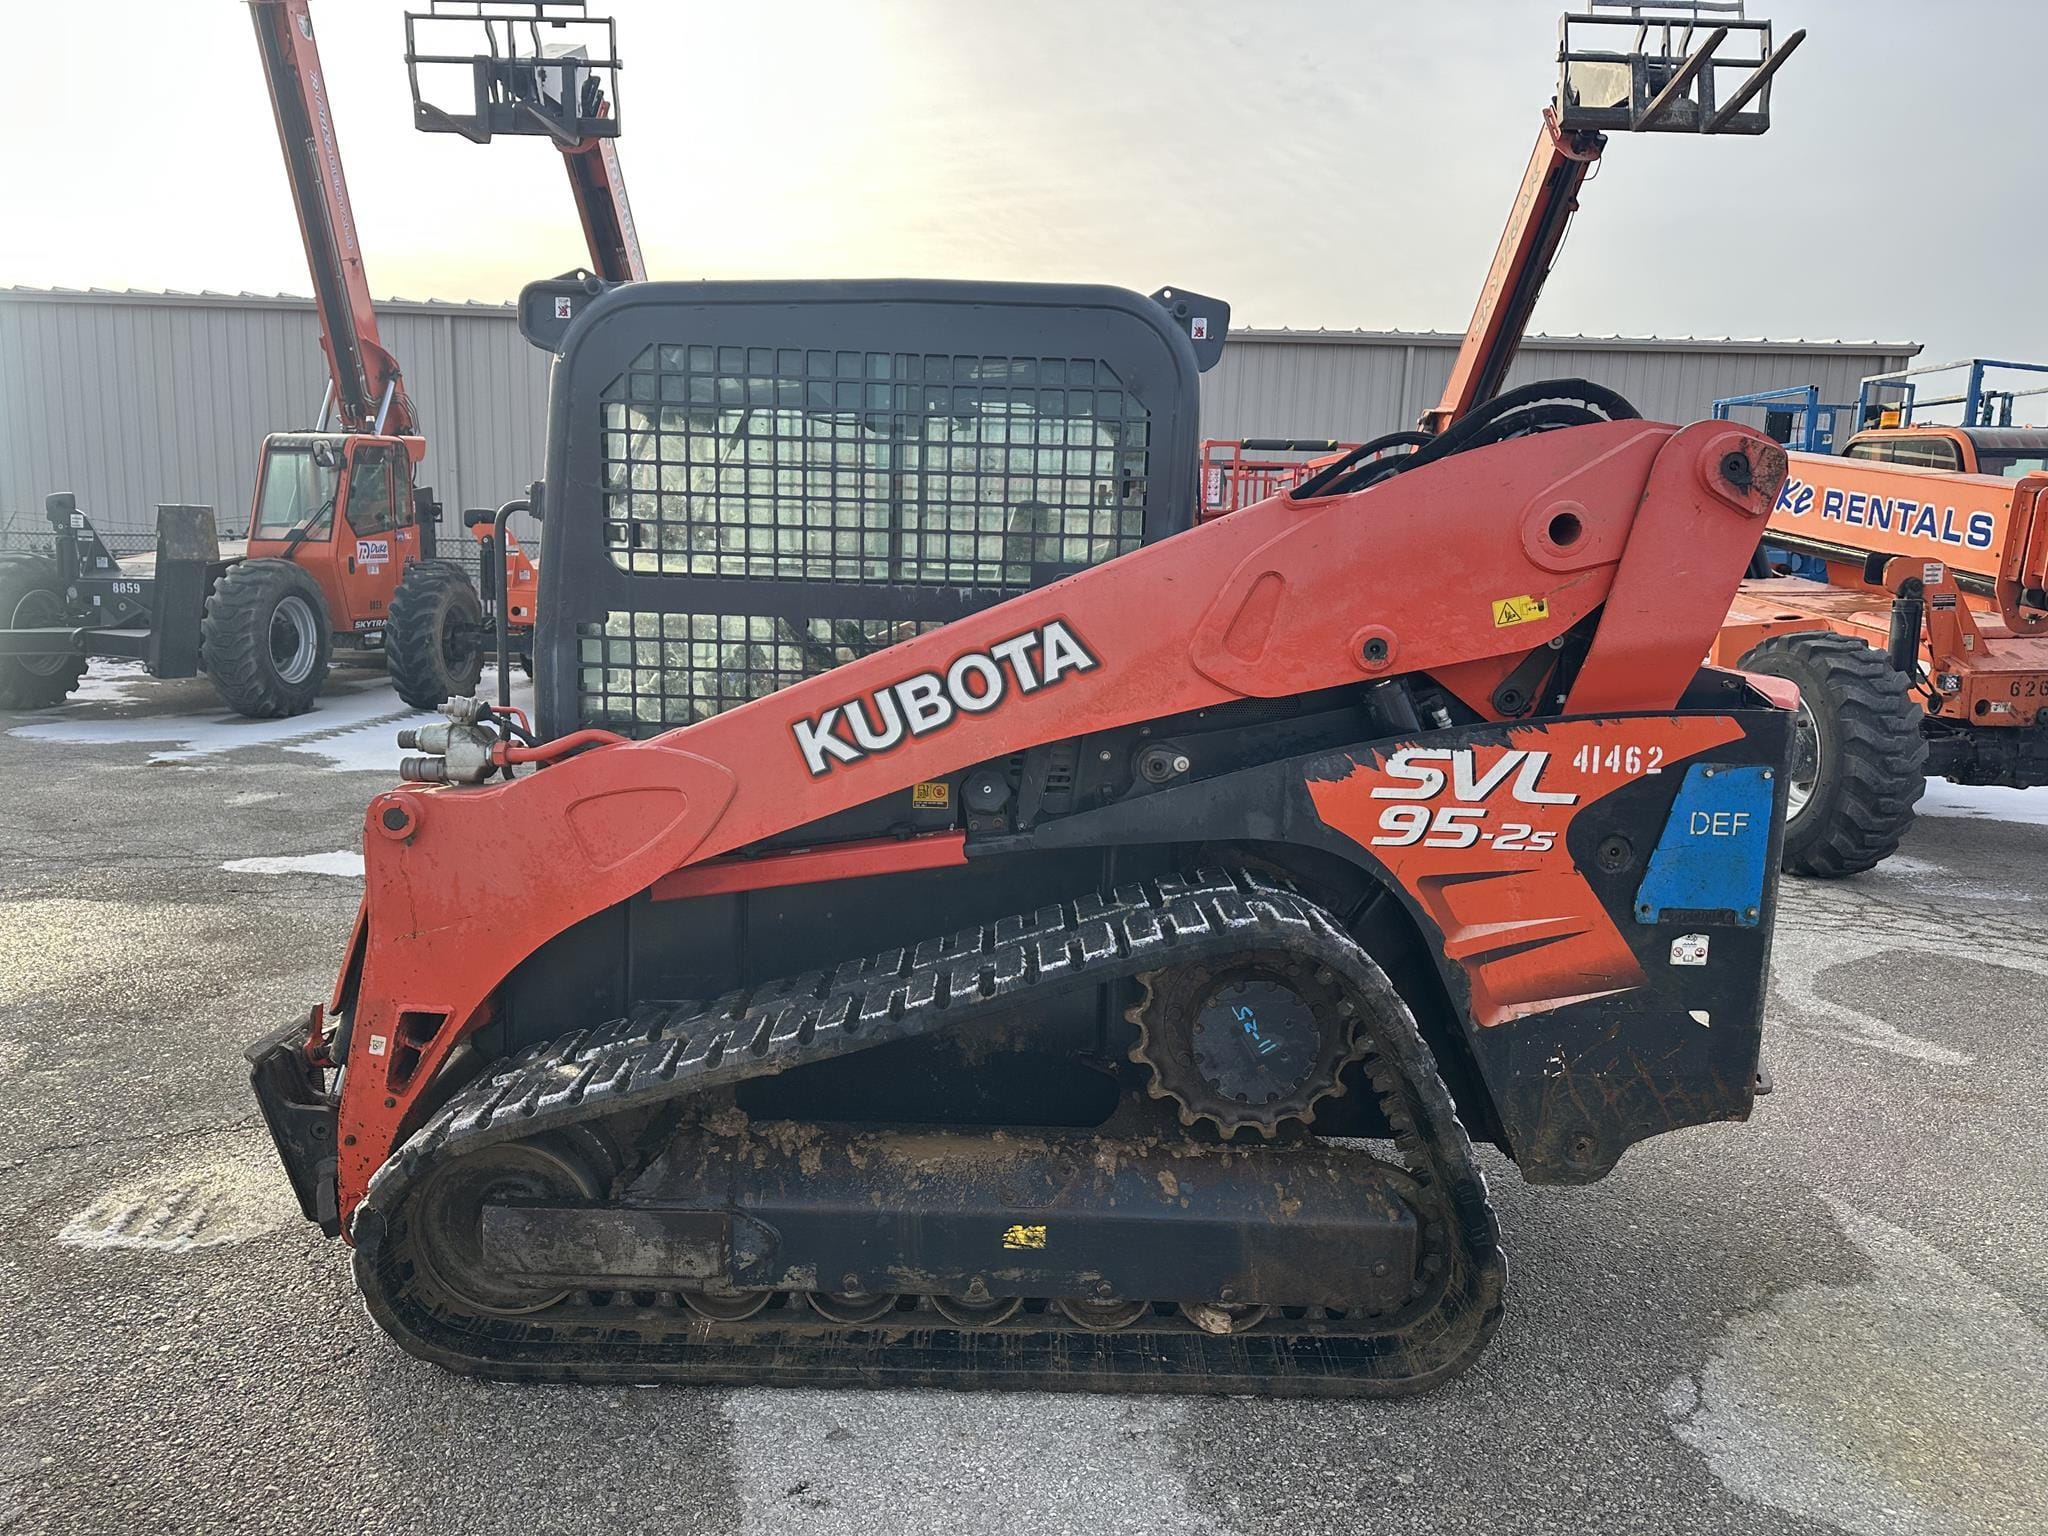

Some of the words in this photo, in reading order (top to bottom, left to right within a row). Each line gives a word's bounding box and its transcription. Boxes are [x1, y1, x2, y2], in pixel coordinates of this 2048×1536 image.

[1822, 490, 1994, 548] RENTALS
[112, 582, 141, 594] 8859
[793, 621, 1095, 776] KUBOTA
[1369, 748, 1580, 806] SVL
[1573, 744, 1663, 775] 41462
[1689, 811, 1750, 836] DEF
